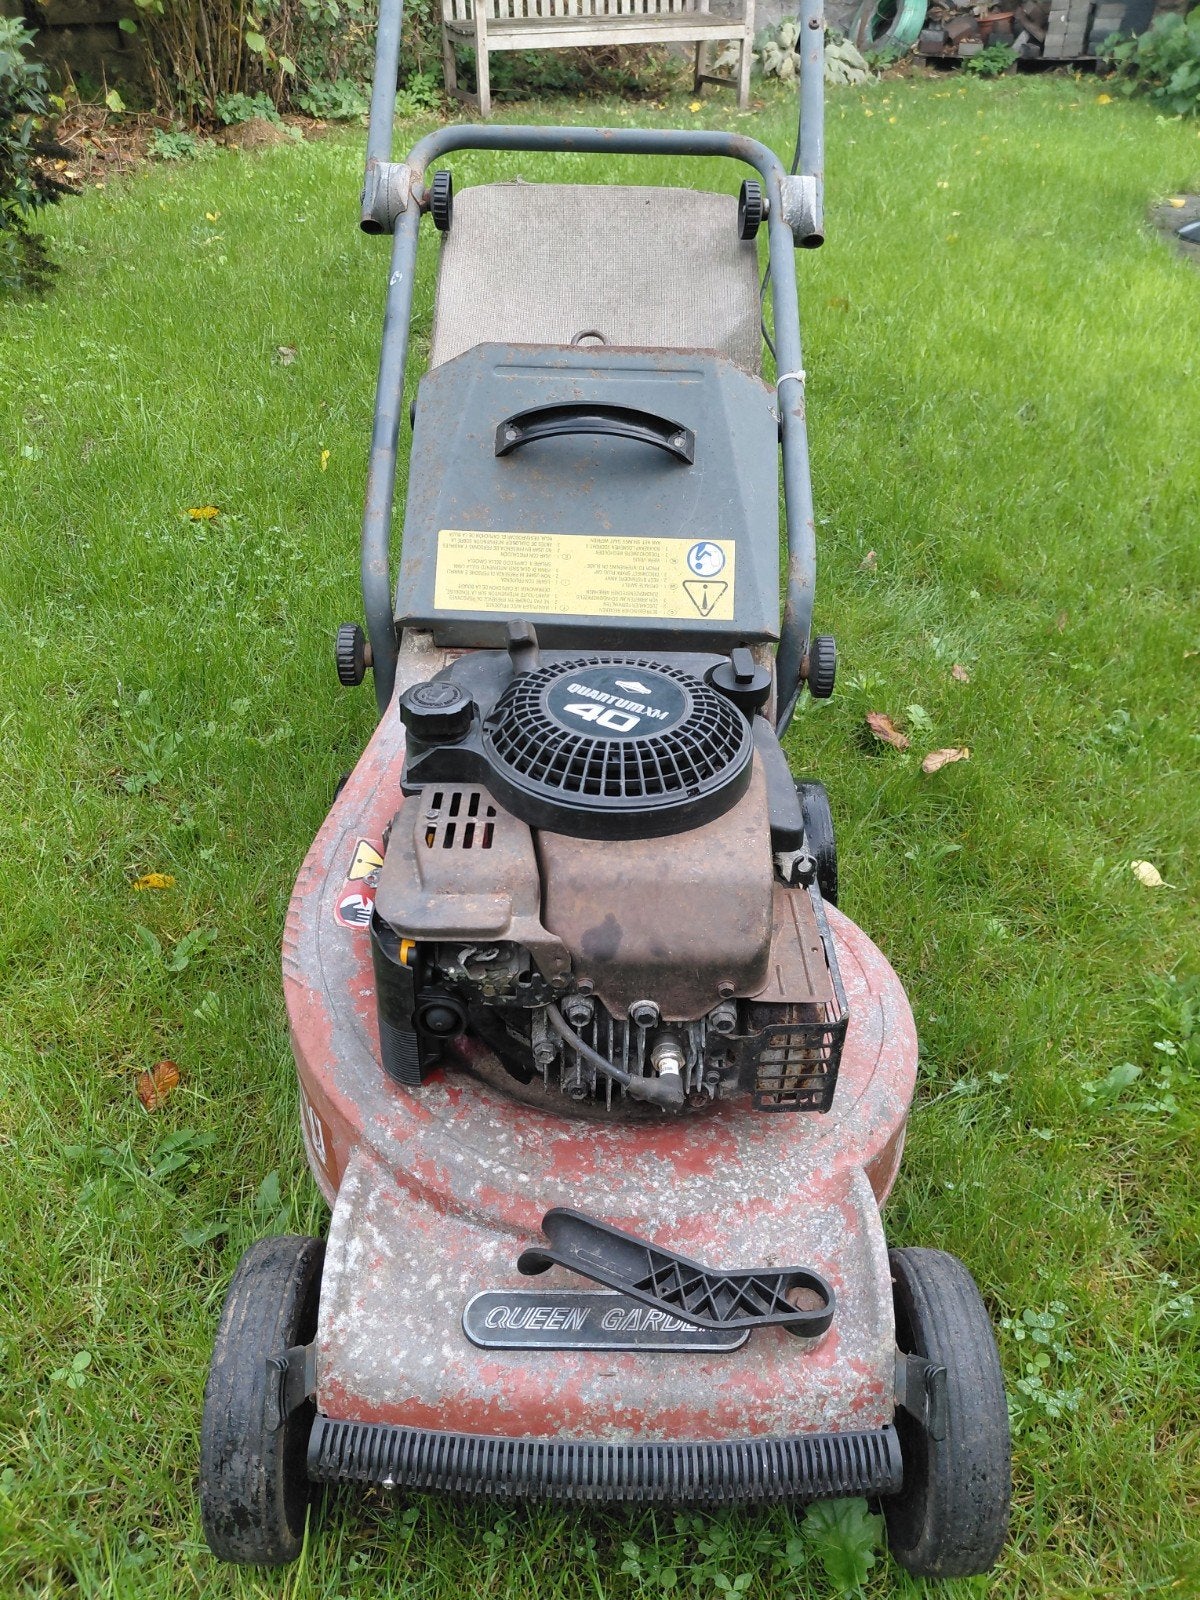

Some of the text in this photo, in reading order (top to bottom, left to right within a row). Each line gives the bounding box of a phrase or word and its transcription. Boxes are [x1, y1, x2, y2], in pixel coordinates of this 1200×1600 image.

[563, 703, 641, 732] 40
[484, 1305, 718, 1333] QUEEN GARD
